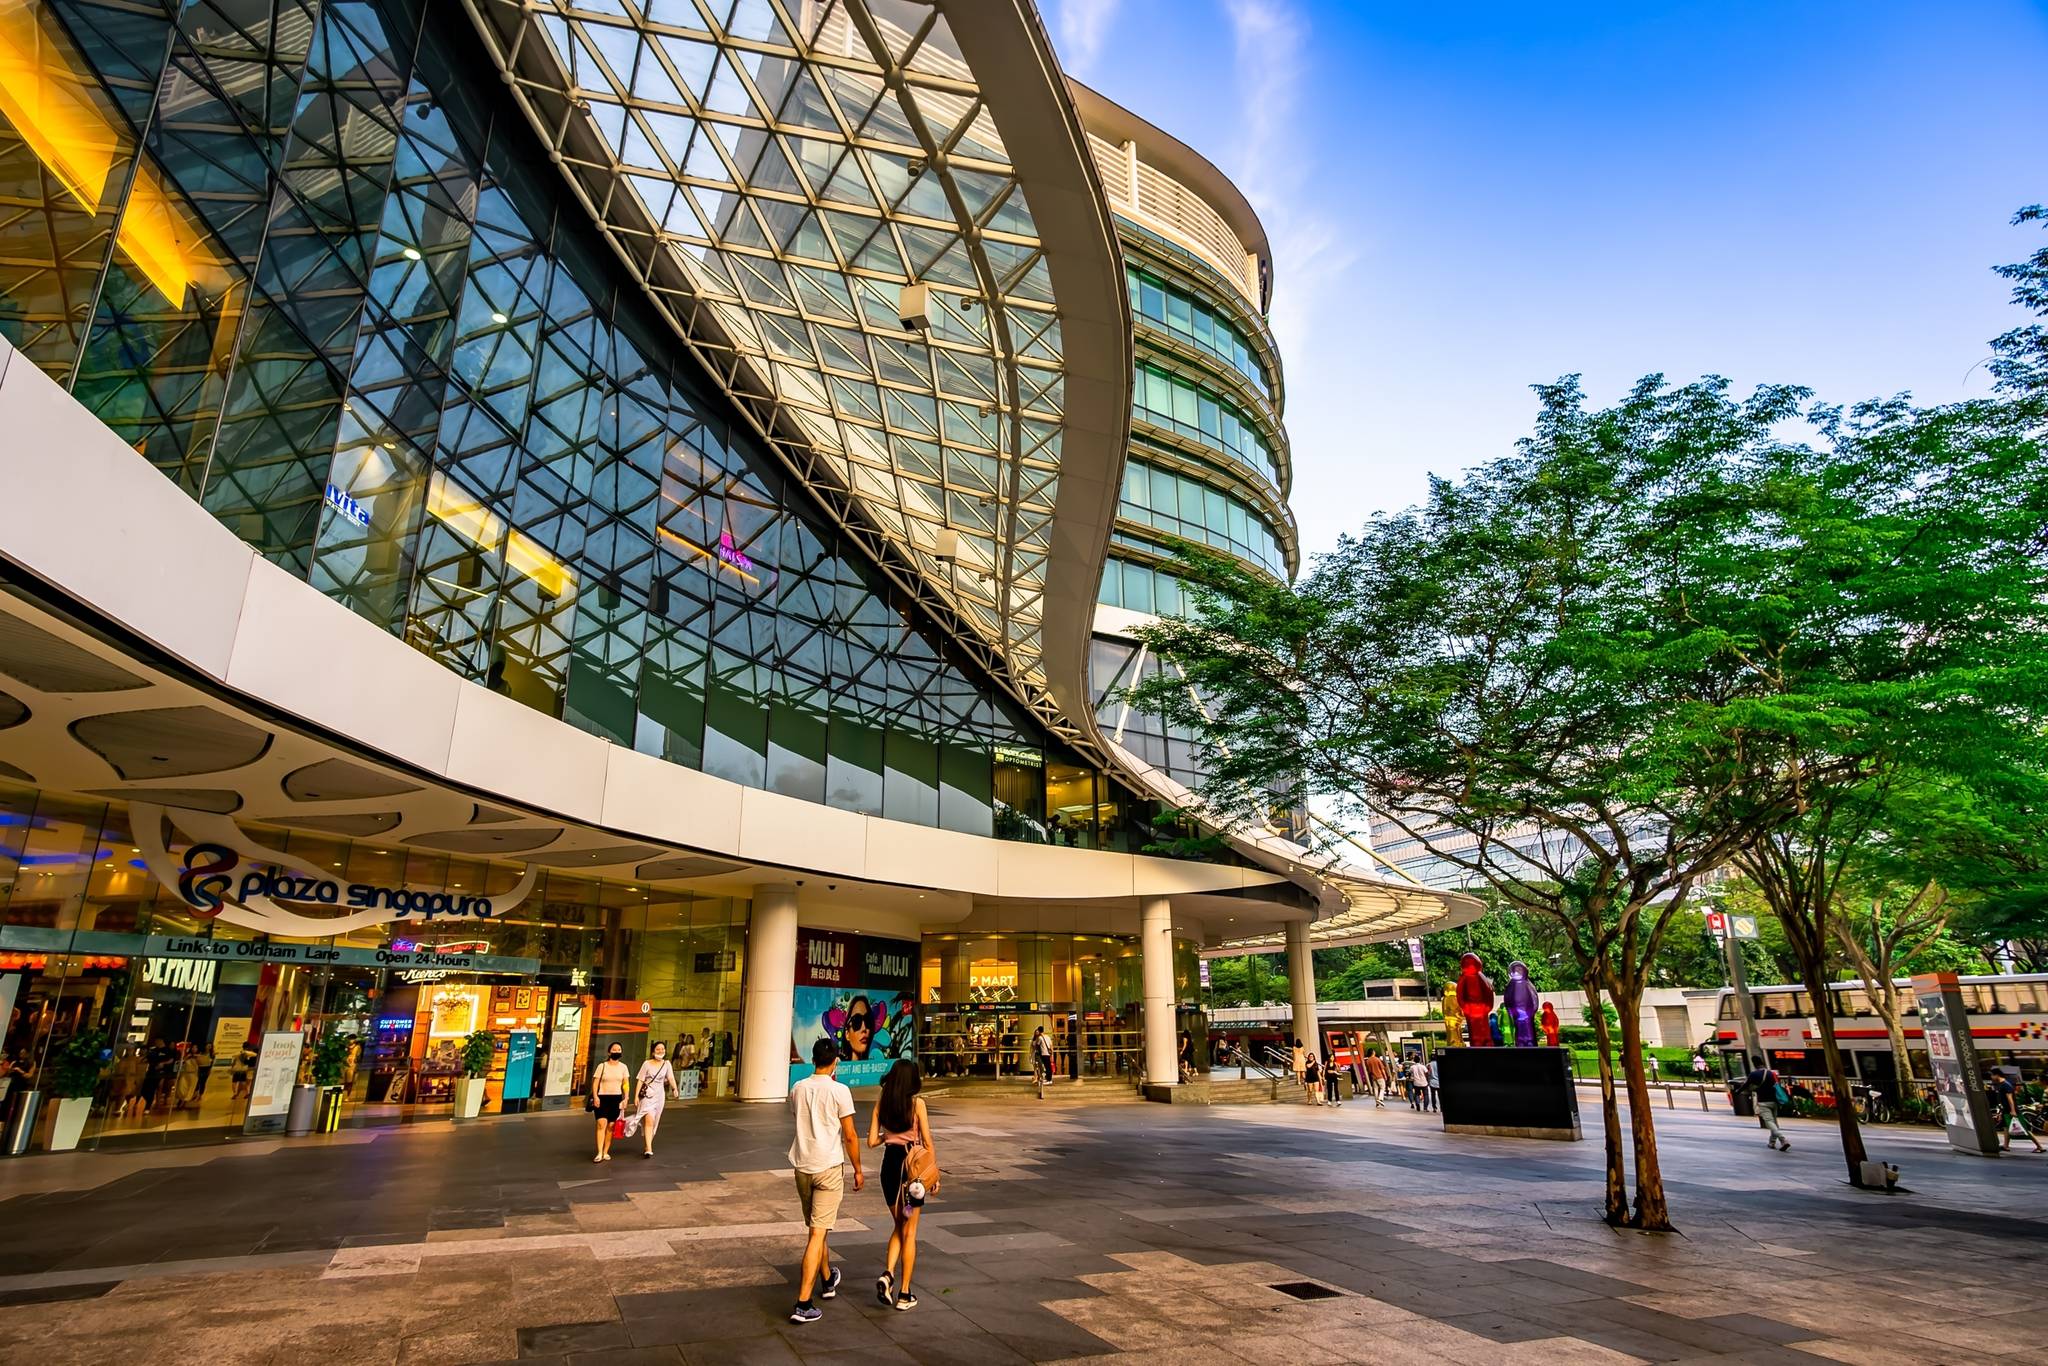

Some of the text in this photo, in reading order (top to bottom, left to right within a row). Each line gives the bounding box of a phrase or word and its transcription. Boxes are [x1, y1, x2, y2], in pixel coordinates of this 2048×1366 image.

[239, 867, 492, 920] plaza singapura
[166, 938, 470, 967] Link to Oldham Lane Open 24 Hours
[808, 940, 845, 967] MUJI
[811, 967, 840, 981] 無印良品
[882, 954, 909, 977] MUJI
[981, 975, 1015, 986] MART
[1760, 1029, 1790, 1037] SMRT
[1958, 1030, 1981, 1092] plaza singapura
